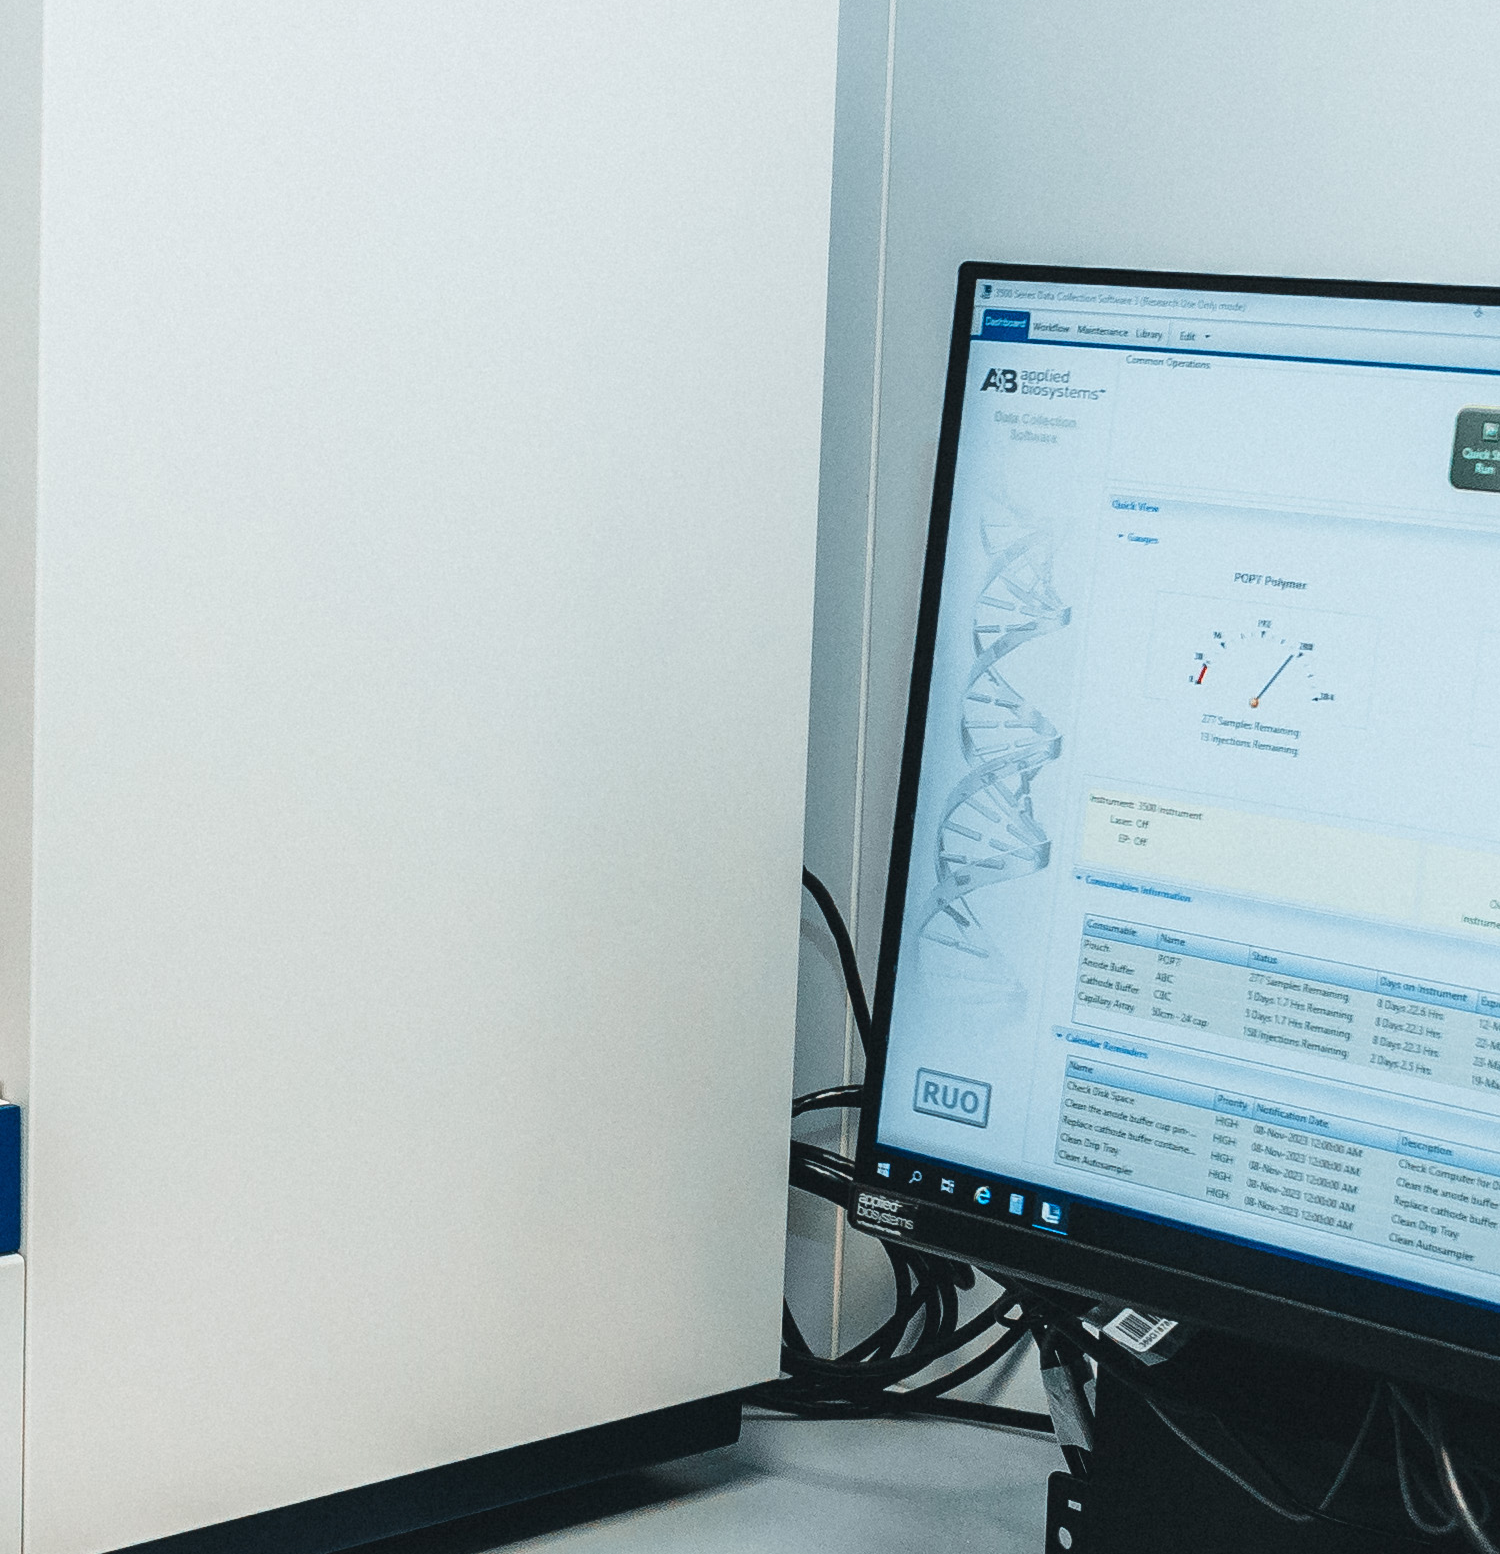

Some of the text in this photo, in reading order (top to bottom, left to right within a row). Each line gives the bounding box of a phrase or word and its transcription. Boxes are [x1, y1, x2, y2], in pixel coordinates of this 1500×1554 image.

[984, 316, 1196, 342] Dashboard Workflow Maintenance Library Edit
[1019, 366, 1070, 385] applied
[1125, 354, 1211, 372] Common Operations
[1111, 499, 1160, 513] Quick View
[1263, 575, 1308, 593] Polymer
[1253, 721, 1300, 740] Remaining
[1251, 739, 1299, 758] Remaining
[1086, 918, 1137, 937] Consumable
[1160, 933, 1186, 947] Name
[1250, 951, 1277, 966] Status
[1378, 976, 1402, 992] Days
[1402, 983, 1415, 993] on
[1417, 984, 1467, 1004] Instrument
[1065, 1033, 1101, 1049] Calendar
[923, 1080, 979, 1114] RUO
[1065, 1080, 1091, 1095] Check
[1214, 1115, 1239, 1130] HIGH
[1397, 1157, 1427, 1174] Check
[1428, 1165, 1475, 1188] Computer
[1475, 1176, 1491, 1189] for
[1256, 1102, 1306, 1123] Notification
[1308, 1114, 1329, 1129] Date
[1400, 1135, 1452, 1159] Description
[1212, 1133, 1237, 1148] HIGH
[1395, 1176, 1421, 1192] Clean
[1422, 1182, 1438, 1196] the
[1439, 1186, 1468, 1203] anode
[1469, 1194, 1500, 1211] buffer
[1392, 1194, 1429, 1214] Replace
[1429, 1203, 1468, 1222] cathode
[1469, 1213, 1498, 1230] buffer
[1390, 1213, 1460, 1242] Clean Drip Tray
[1388, 1231, 1474, 1265] Clean Autosampler
